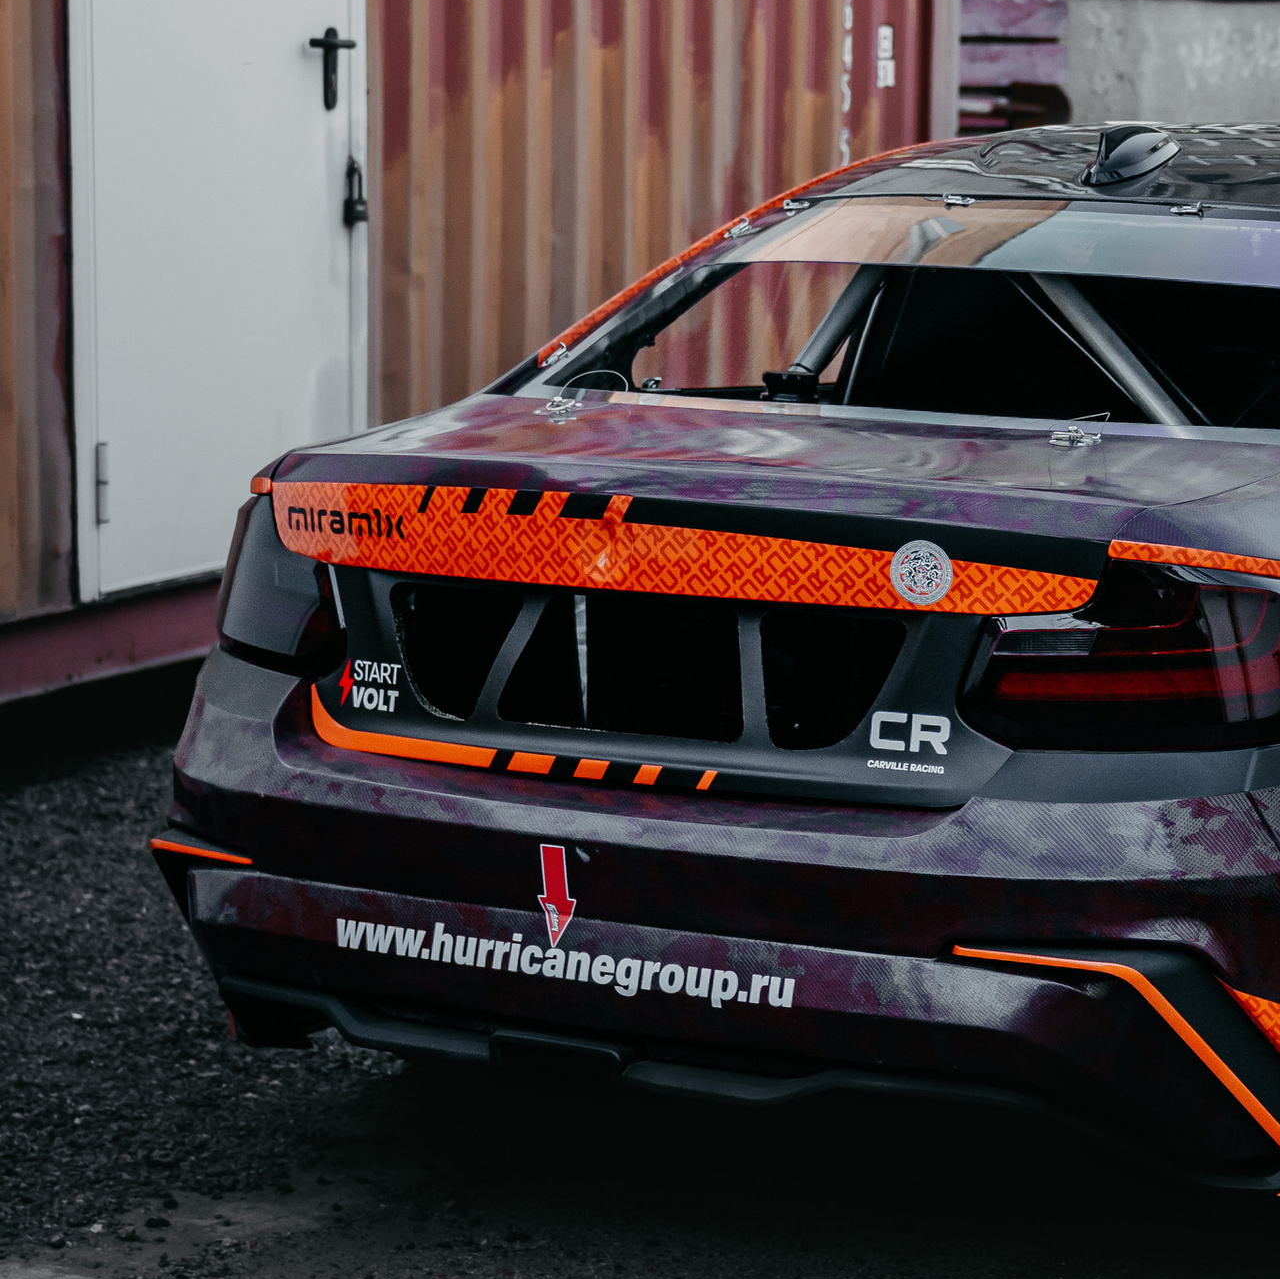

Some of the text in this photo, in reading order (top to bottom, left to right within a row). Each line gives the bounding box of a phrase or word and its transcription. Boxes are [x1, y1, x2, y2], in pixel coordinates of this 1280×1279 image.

[353, 659, 402, 685] START
[352, 685, 399, 713] VOLT
[869, 711, 952, 755] CR
[867, 759, 945, 775] CARVILLE RACING
[336, 918, 796, 1008] www.hurricanegroup.ru
